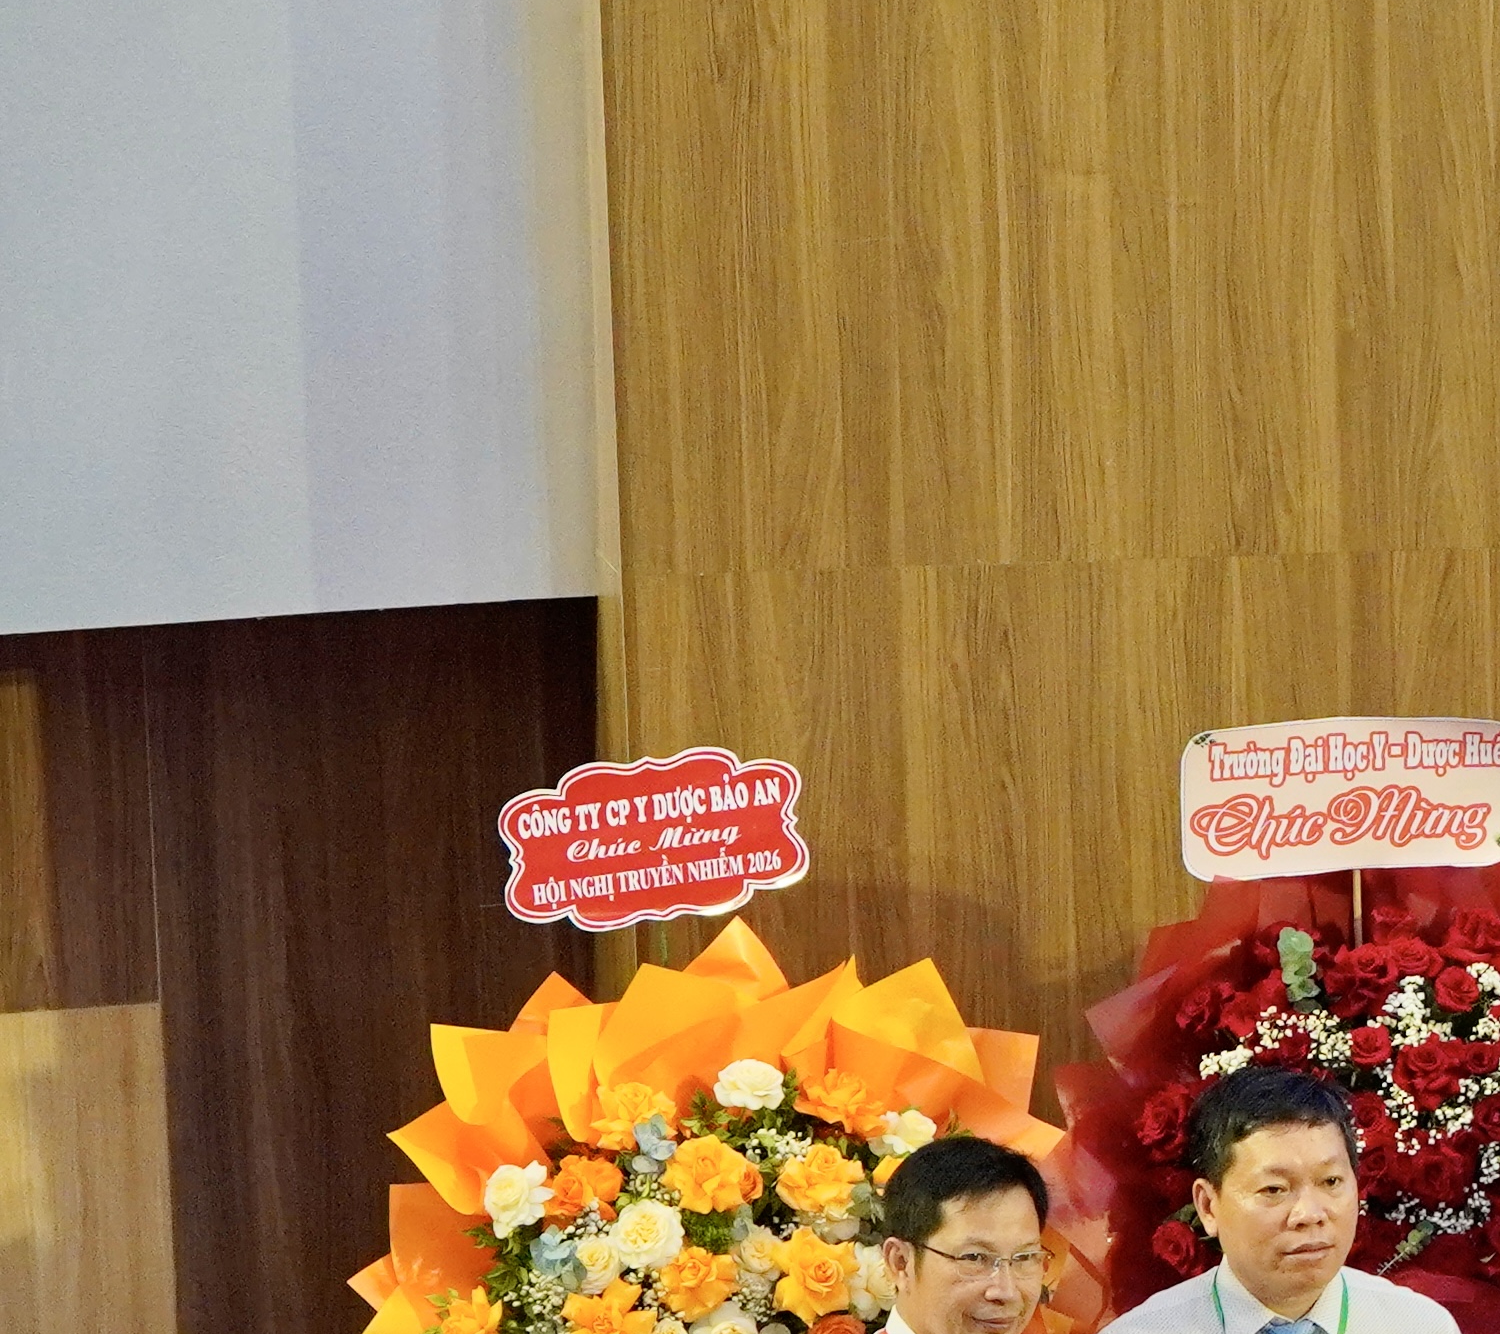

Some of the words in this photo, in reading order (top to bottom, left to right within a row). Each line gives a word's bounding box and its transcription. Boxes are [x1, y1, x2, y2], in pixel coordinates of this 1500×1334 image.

[1208, 741, 1286, 788] Trường
[1289, 737, 1324, 783] Đại
[1327, 733, 1369, 781] Học
[1370, 731, 1389, 770] Y
[1404, 731, 1462, 776] Dược
[517, 804, 572, 839] CÔNG
[575, 803, 601, 831] TY
[606, 799, 627, 826] CP
[635, 795, 648, 823] Y
[652, 788, 706, 823] DƯỢC
[709, 774, 748, 811] BẢO
[754, 777, 781, 806] AN
[1190, 793, 1326, 859] Chúc
[1329, 784, 1491, 850] Mừng
[567, 837, 641, 862] Chúc
[650, 825, 742, 851] Mừng
[533, 876, 566, 908] HỘI
[571, 873, 614, 901] NGHỊ
[617, 855, 683, 893] TRUYỀN
[687, 848, 744, 883] NHIỄM
[746, 849, 781, 874] 2026
